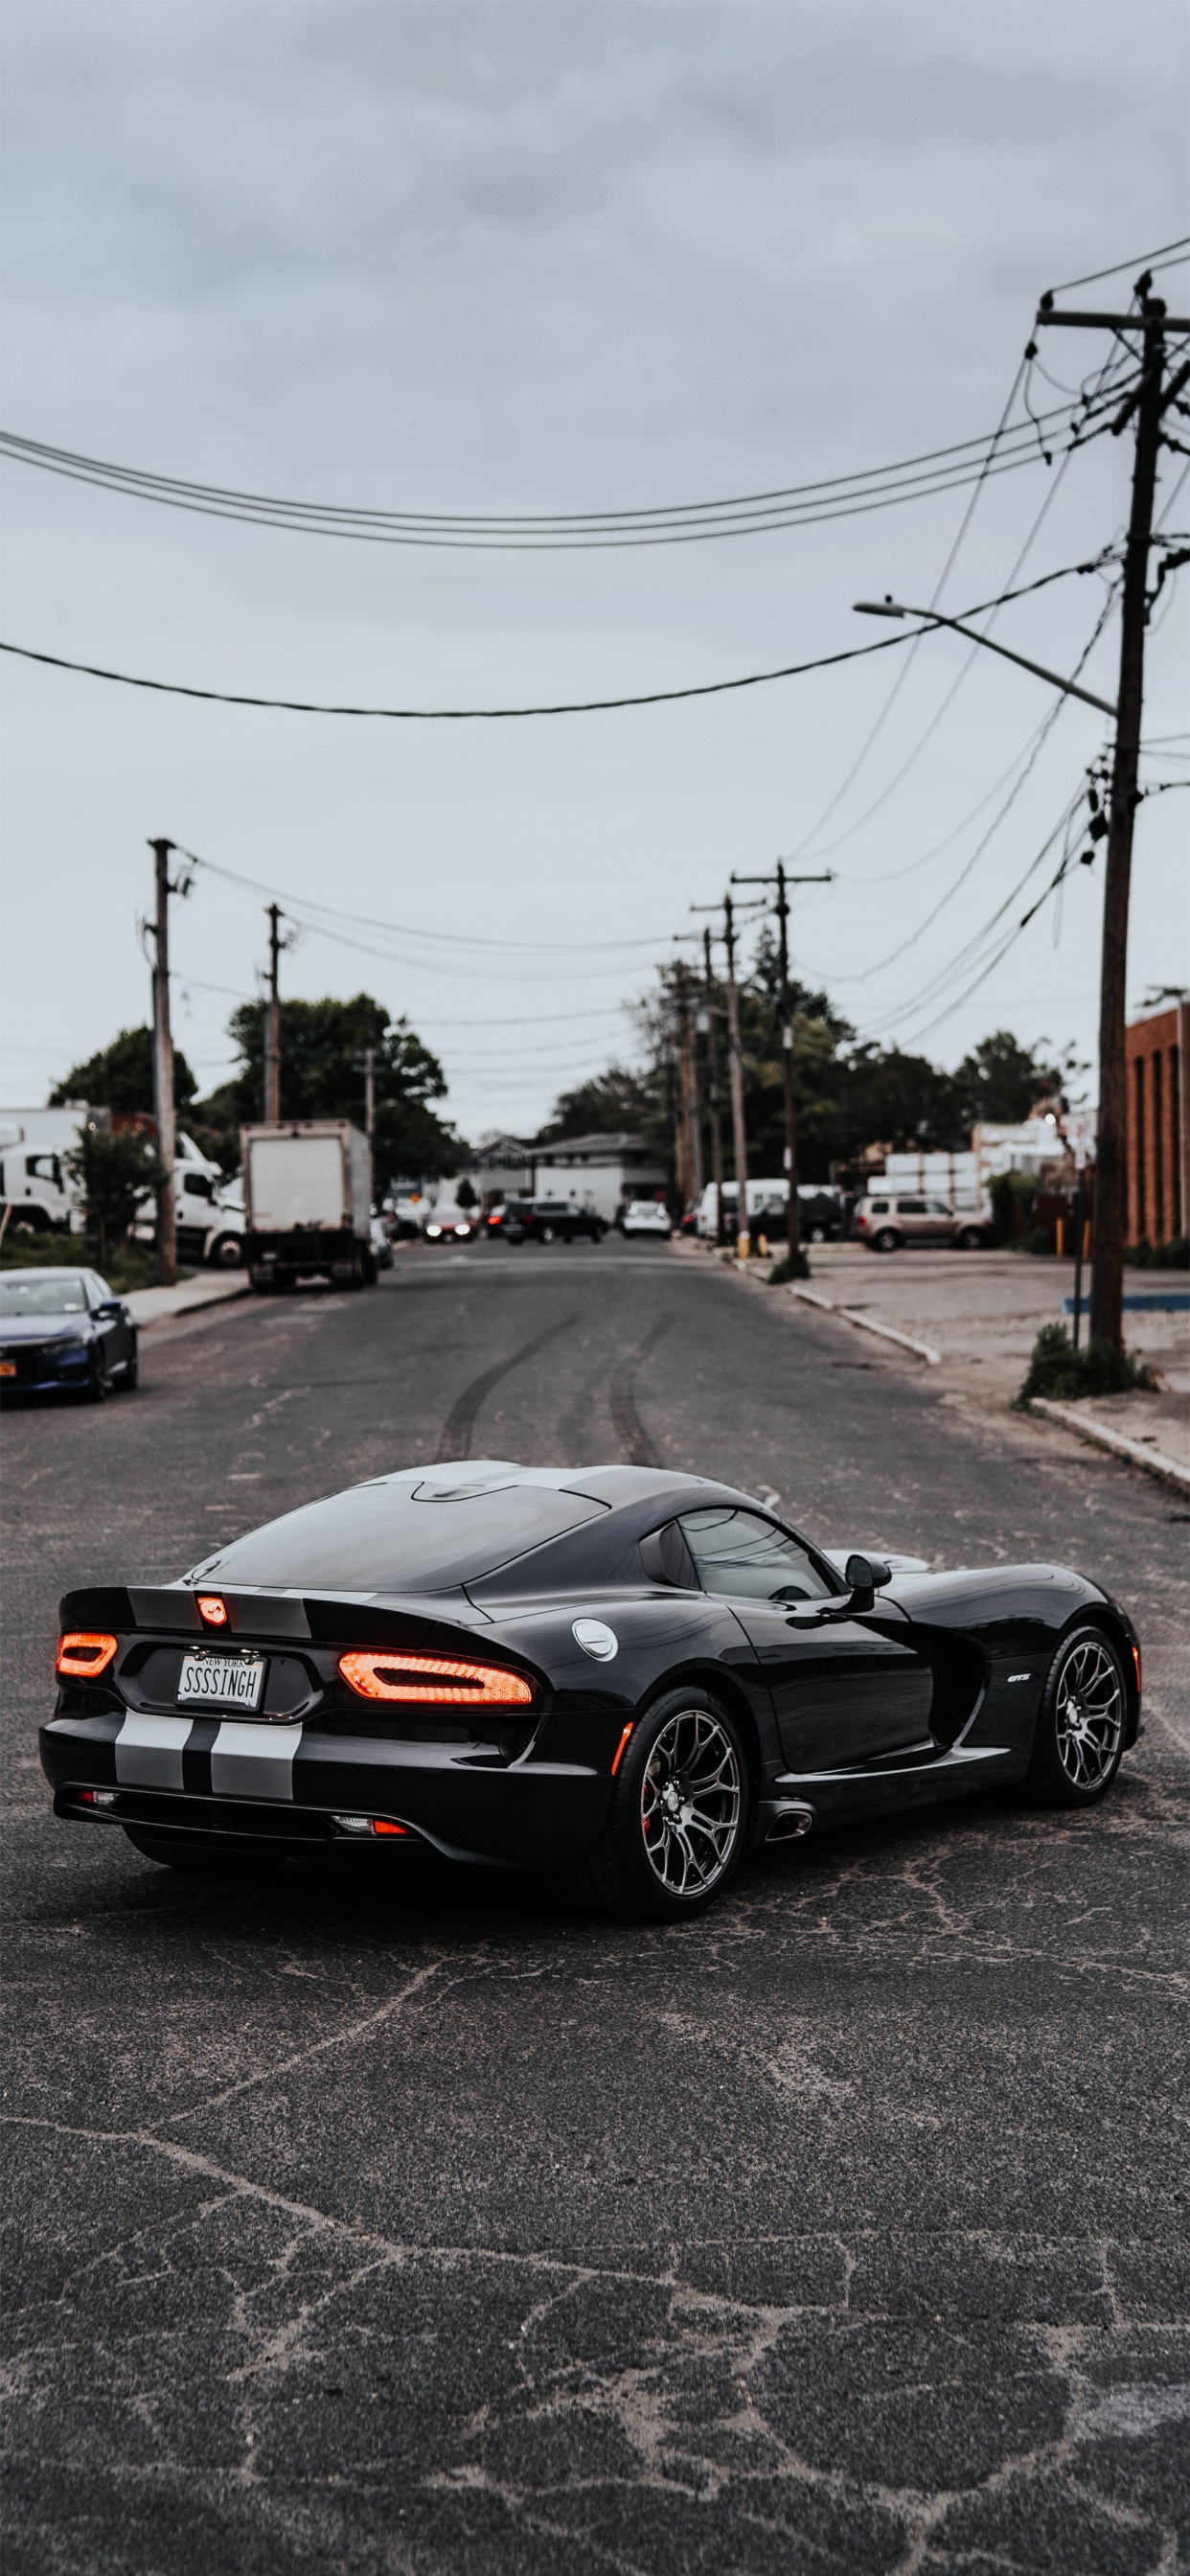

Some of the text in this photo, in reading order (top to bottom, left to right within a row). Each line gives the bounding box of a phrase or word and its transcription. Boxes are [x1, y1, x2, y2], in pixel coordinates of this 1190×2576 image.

[203, 1657, 244, 1668] NEW YORK
[184, 1667, 257, 1697] SSSSINGH
[1007, 1673, 1031, 1682] GTS
